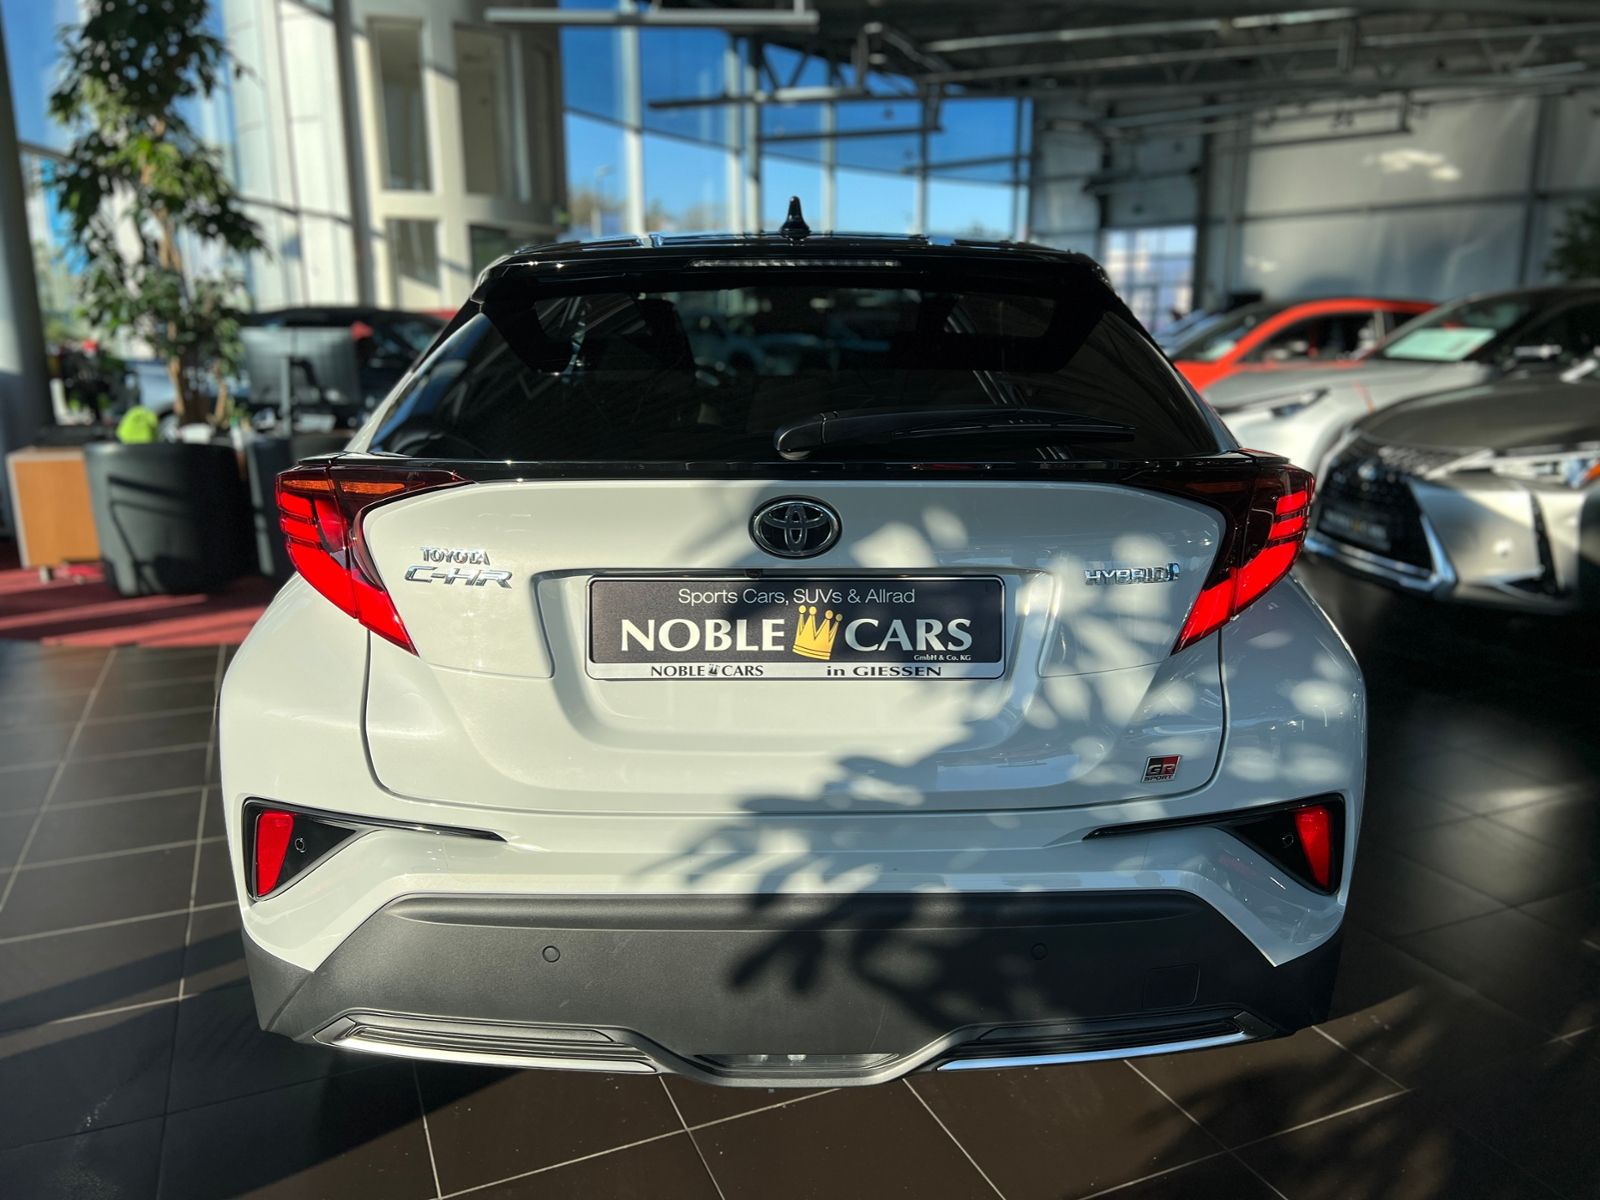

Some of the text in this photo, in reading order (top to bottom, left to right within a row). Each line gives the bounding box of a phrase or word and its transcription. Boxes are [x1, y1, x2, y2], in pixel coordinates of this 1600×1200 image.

[420, 547, 491, 566] TOYOTA
[404, 565, 512, 589] C-HR
[1085, 567, 1169, 585] HYBRID
[678, 588, 915, 606] Sports Cars, SUVs & Allrad
[621, 618, 973, 652] NOBLE CARS
[651, 665, 764, 677] NOBLE CARS
[827, 665, 942, 677] in GIESSEN
[1144, 774, 1173, 782] SPORT
[1148, 764, 1176, 775] GR
